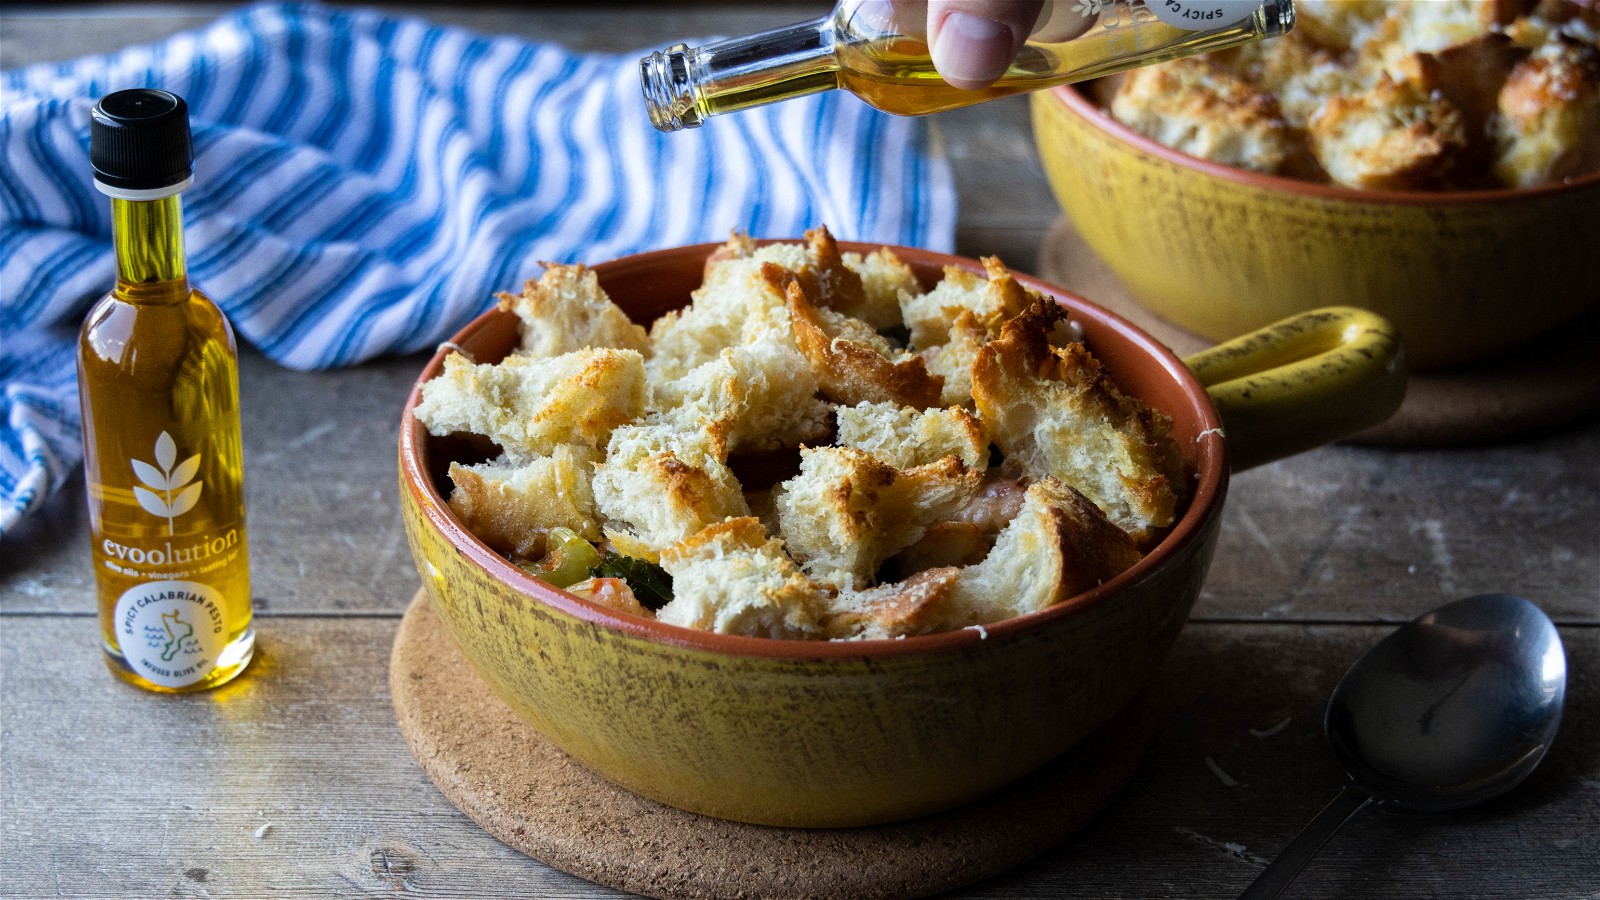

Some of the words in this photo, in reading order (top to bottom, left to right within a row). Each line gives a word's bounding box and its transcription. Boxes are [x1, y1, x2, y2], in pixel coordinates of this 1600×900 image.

[1182, 9, 1223, 20] SPICY
[103, 528, 238, 565] evoolution
[148, 571, 190, 580] vinegars
[125, 606, 138, 635] SPICY
[137, 591, 206, 608] CALABRIAN
[205, 601, 223, 634] PESTO
[141, 658, 171, 677] INFUSED
[173, 666, 196, 677] OLIVE
[196, 658, 208, 668] OIL
